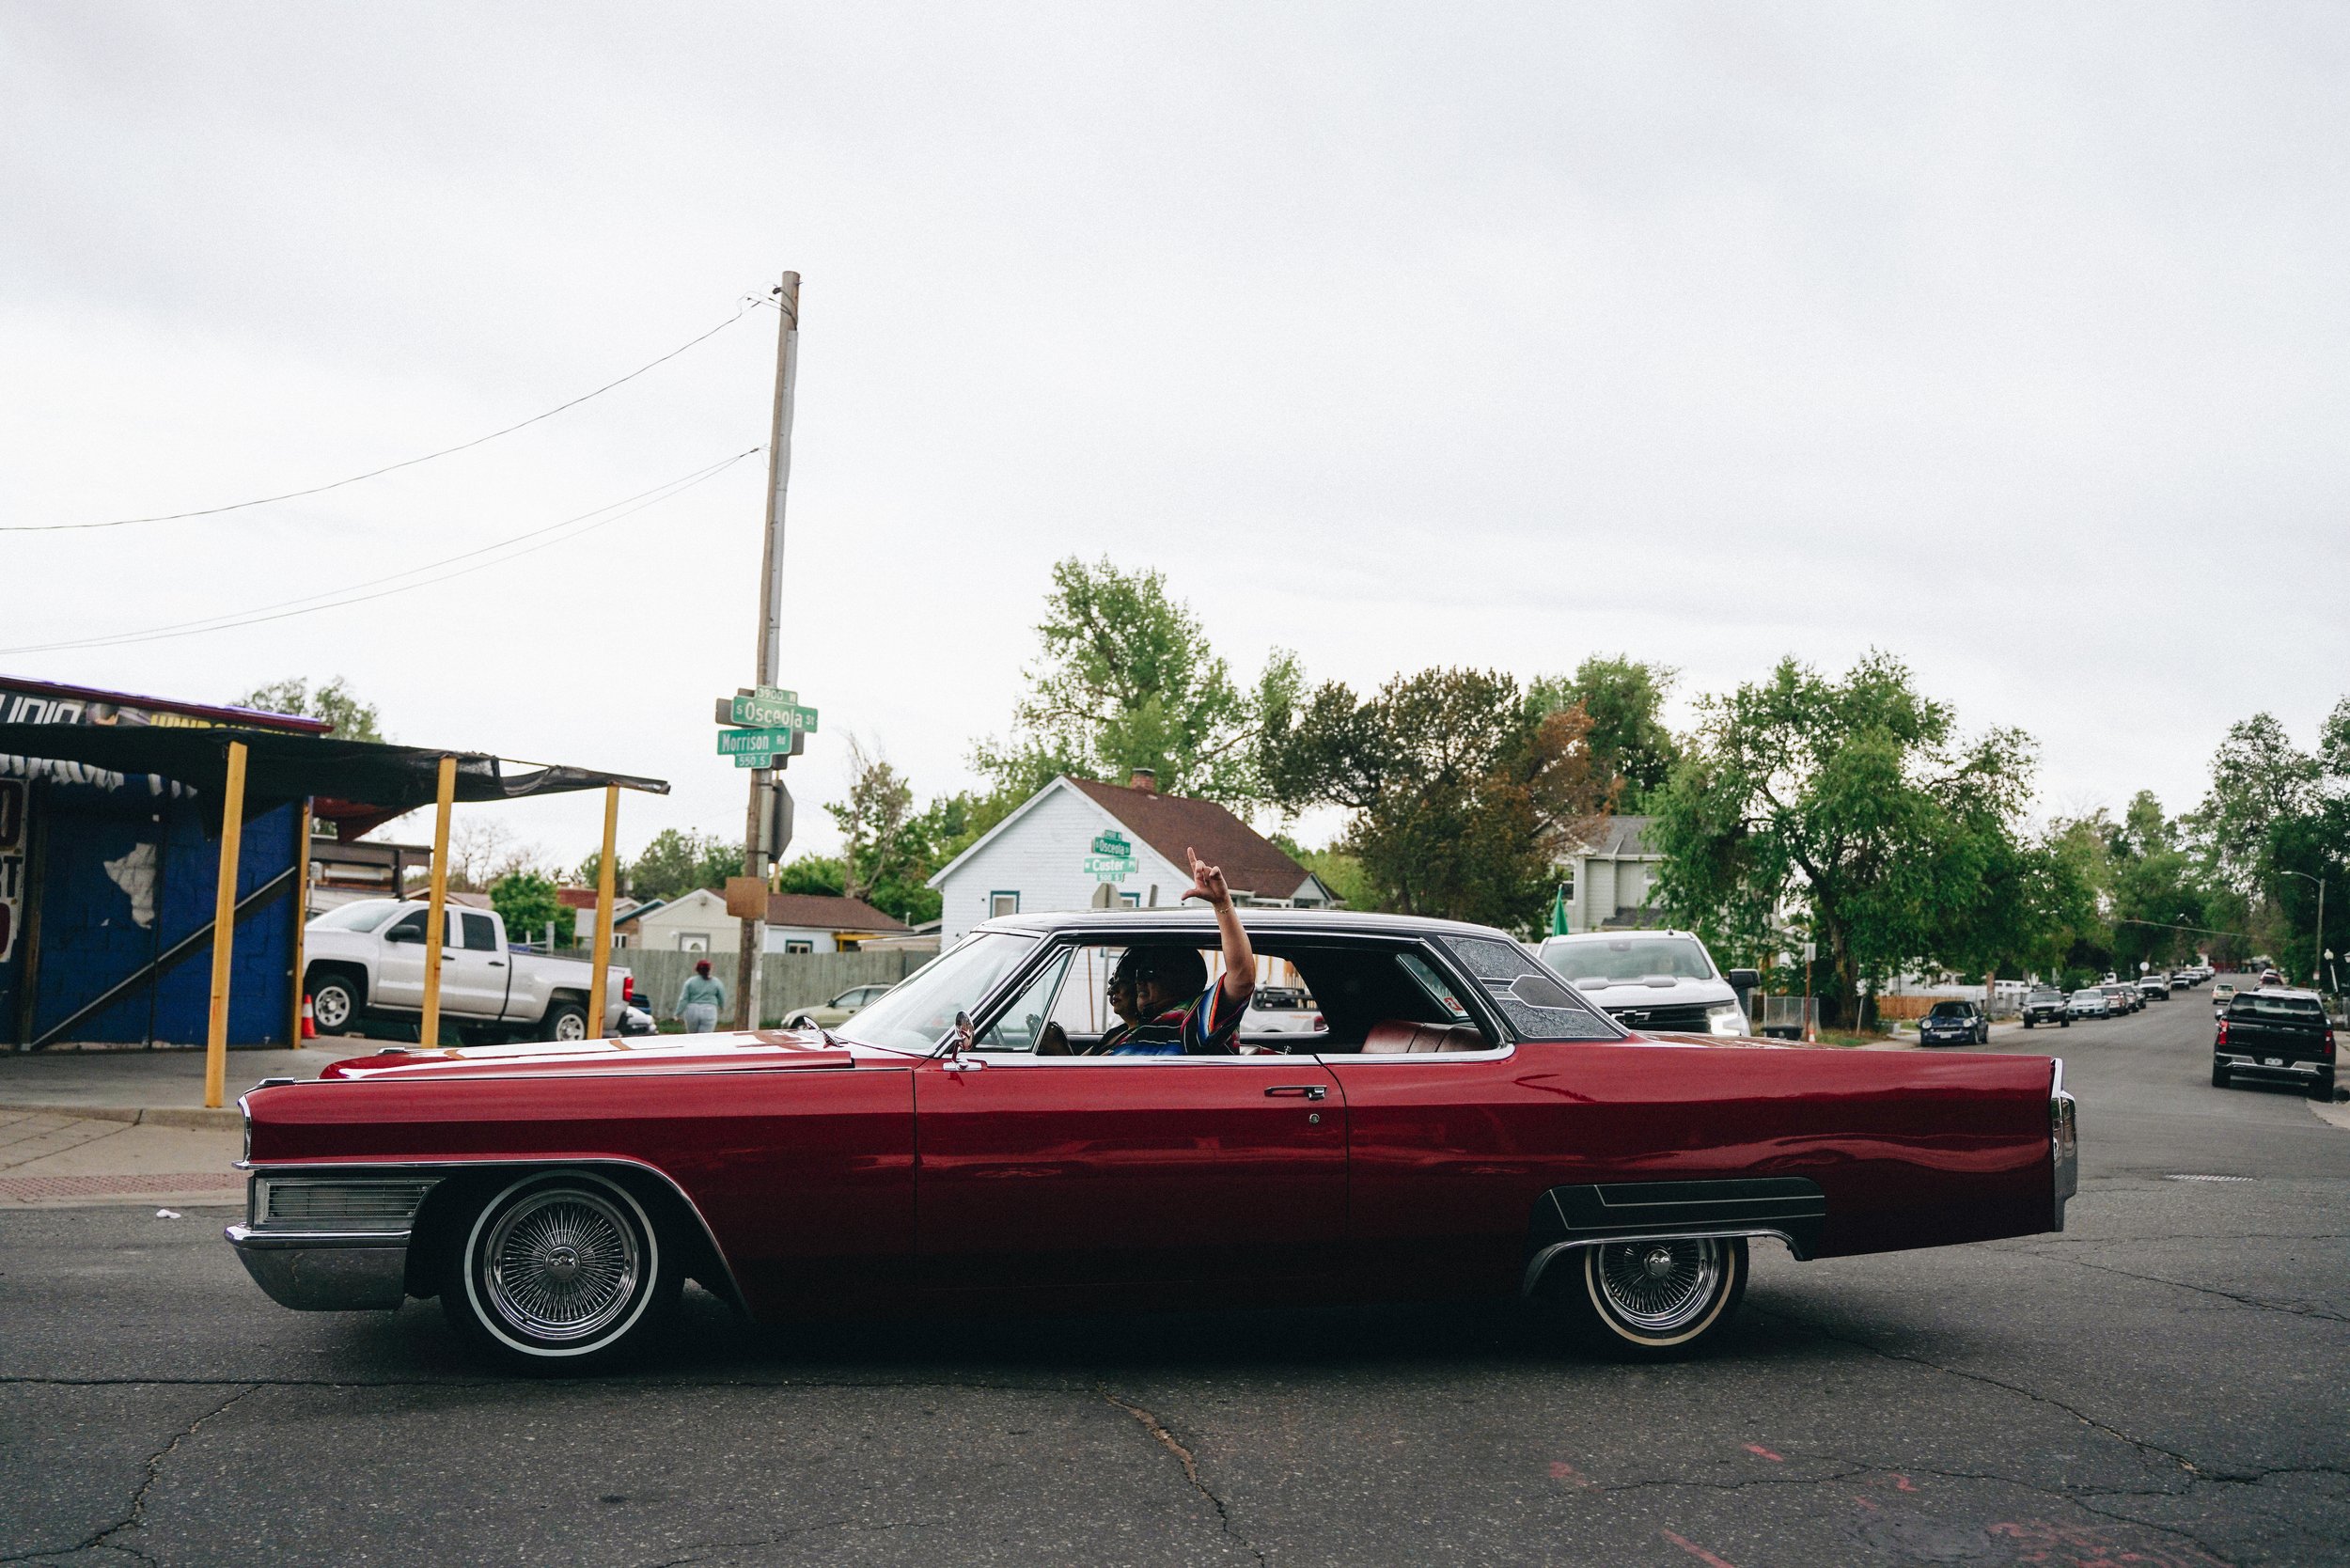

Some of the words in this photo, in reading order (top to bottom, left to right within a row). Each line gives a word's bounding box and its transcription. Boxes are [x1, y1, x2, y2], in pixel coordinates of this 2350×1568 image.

[759, 688, 783, 700] 3900
[736, 705, 743, 714] S
[744, 702, 803, 728] Osceola
[806, 714, 815, 726] St
[722, 732, 769, 753] Morrison
[776, 735, 786, 745] Rd
[739, 756, 756, 767] 550
[1100, 839, 1124, 855] Osceola
[1093, 859, 1124, 871] Custer
